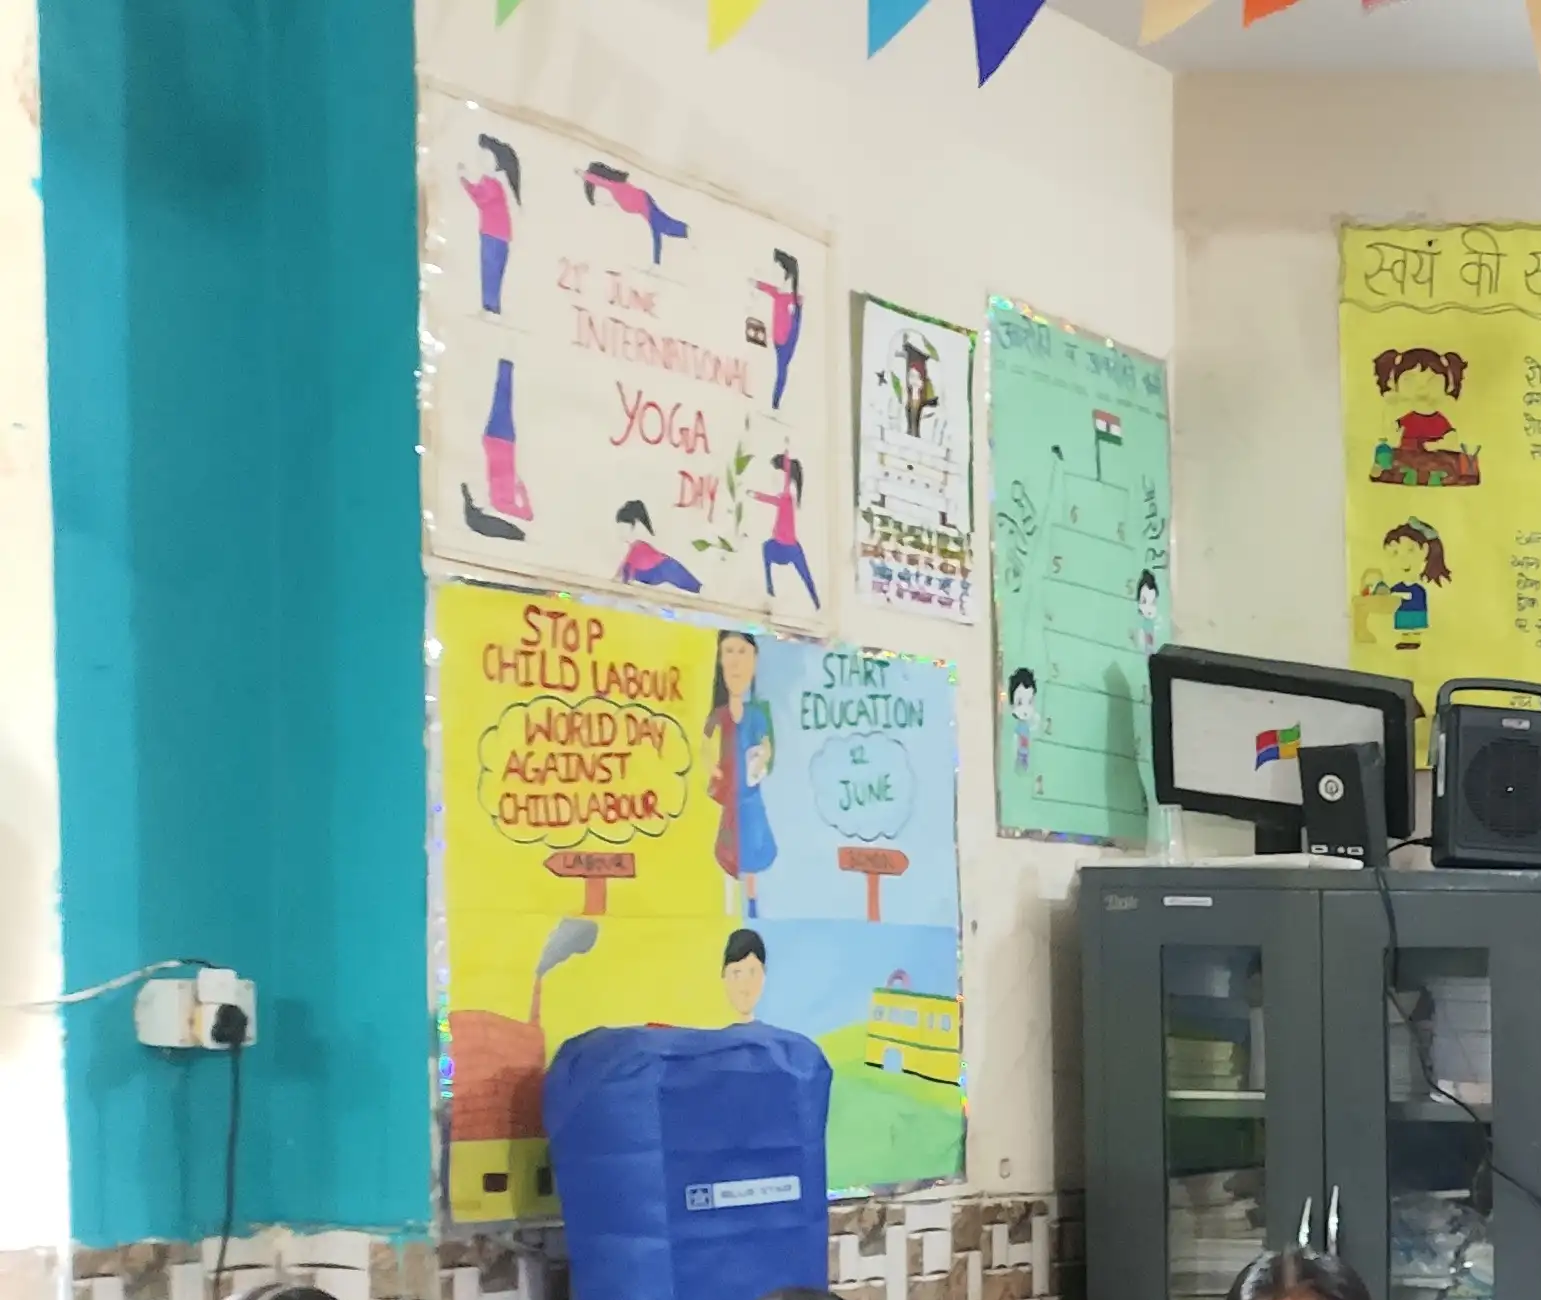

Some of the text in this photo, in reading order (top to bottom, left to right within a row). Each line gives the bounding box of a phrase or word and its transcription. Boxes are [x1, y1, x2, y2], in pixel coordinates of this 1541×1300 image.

[1365, 238, 1441, 298] स्वयं
[1460, 227, 1507, 296] की
[570, 305, 753, 399] INTERNATIONAL
[608, 380, 711, 456] YOGA
[673, 469, 720, 524] DAY
[522, 604, 605, 652] STOP
[482, 643, 684, 701] CHILD LABOUR
[822, 652, 886, 689] START
[524, 707, 668, 757] WORLD DAY
[800, 691, 924, 731] EDUCATION
[501, 750, 632, 784] AGAINST
[837, 784, 894, 812] JUNE
